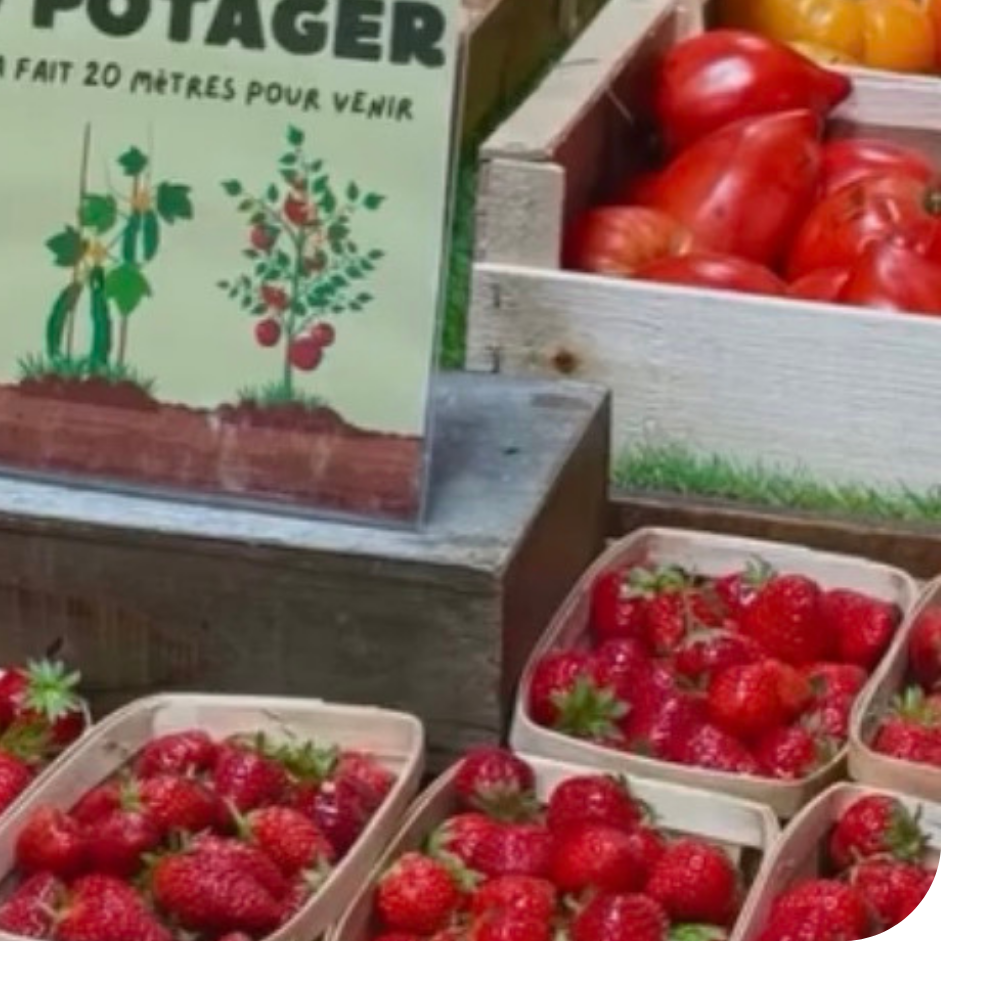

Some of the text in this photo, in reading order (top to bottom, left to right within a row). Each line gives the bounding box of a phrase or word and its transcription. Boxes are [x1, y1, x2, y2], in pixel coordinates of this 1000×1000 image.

[14, 56, 74, 84] FAIT
[83, 60, 122, 89] 20
[246, 80, 322, 111] POUR
[332, 90, 414, 121] VENIR
